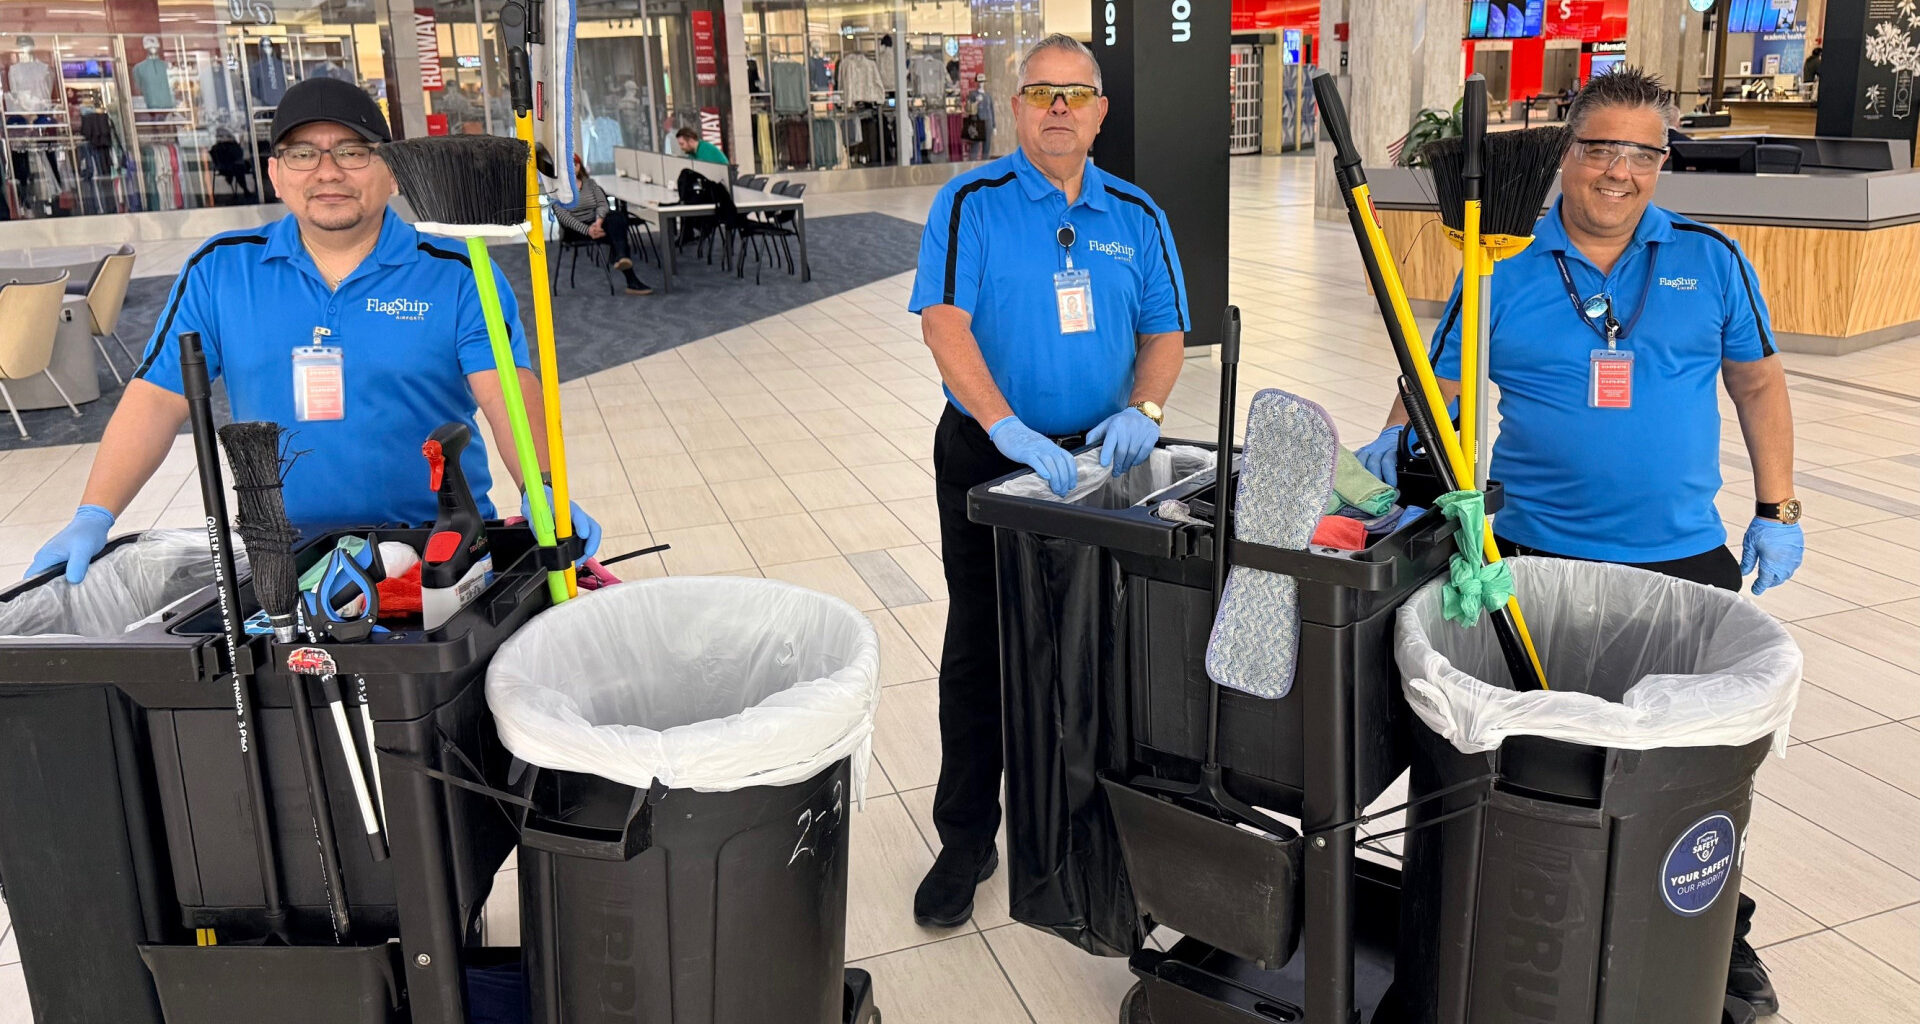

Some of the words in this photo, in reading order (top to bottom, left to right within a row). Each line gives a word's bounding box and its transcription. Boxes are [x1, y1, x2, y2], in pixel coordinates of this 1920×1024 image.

[1105, 0, 1116, 46] on
[414, 14, 442, 87] RUNWAY
[1089, 239, 1135, 259] FlagShip
[1659, 277, 1698, 288] FlagShip
[366, 298, 431, 316] FlagShip
[206, 516, 220, 551] QUIEN
[212, 553, 224, 582] TIENE
[223, 617, 232, 632] NO
[1692, 837, 1719, 854] SAFETY
[1670, 871, 1700, 887] YOUR
[1701, 855, 1730, 878] SAFETY
[1677, 884, 1695, 896] OUR
[1696, 870, 1725, 890] PRIORITY
